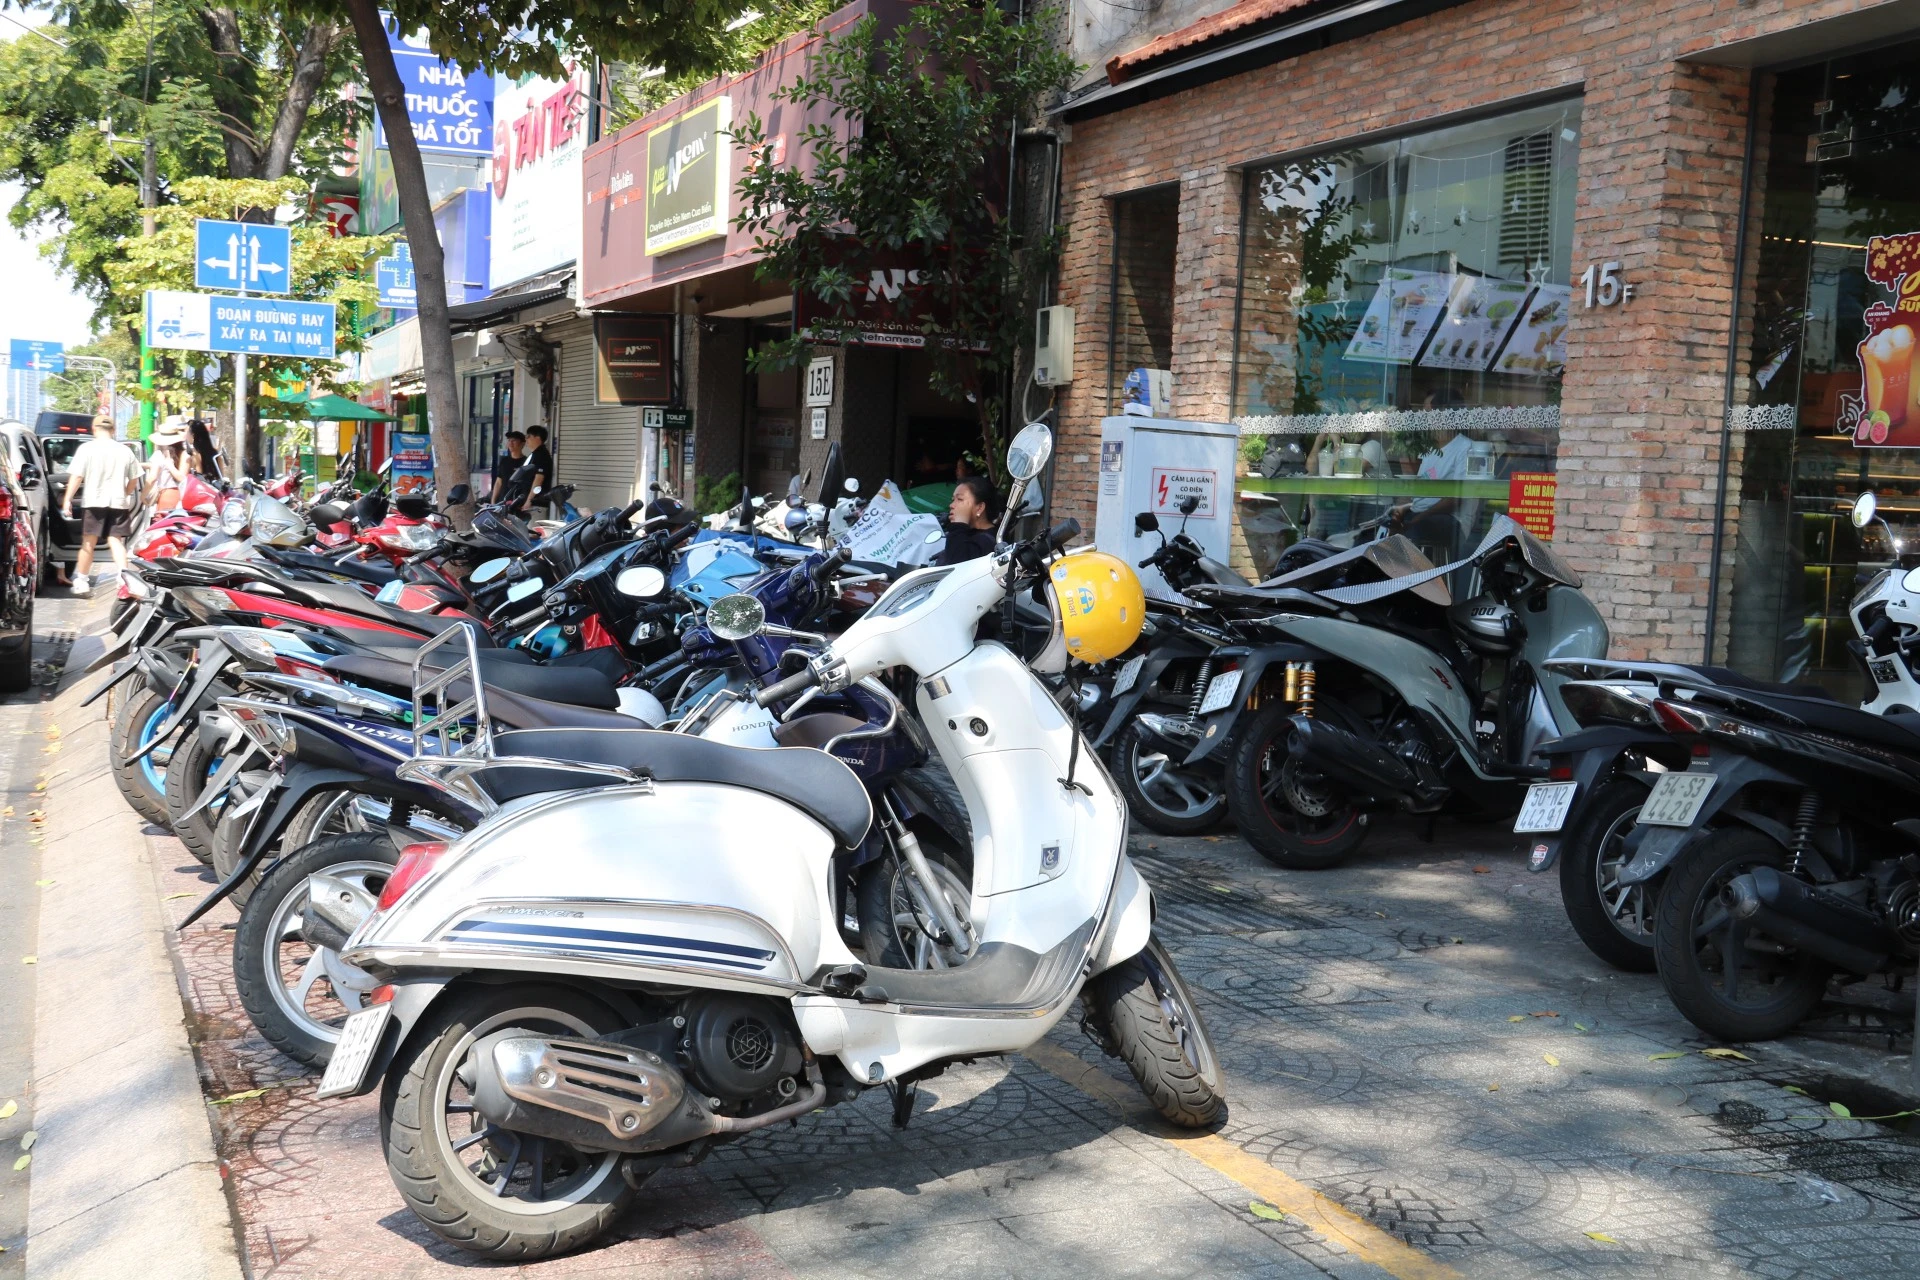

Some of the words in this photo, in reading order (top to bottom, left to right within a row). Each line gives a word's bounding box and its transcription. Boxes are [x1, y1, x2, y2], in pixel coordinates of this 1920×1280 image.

[419, 64, 466, 87] NHÀ
[405, 90, 479, 118] THUỐC
[442, 119, 482, 146] TỐT
[1580, 261, 1633, 308] 15F
[217, 307, 252, 324] ĐOẠN
[256, 308, 297, 326] ĐƯỜNG
[302, 313, 325, 327] HAY
[221, 323, 245, 340] XẢY
[250, 328, 267, 342] RA
[273, 330, 292, 343] TAI
[296, 332, 322, 348] NẠN
[810, 366, 831, 397] 15E
[666, 413, 687, 421] TOILET
[1524, 482, 1540, 497] CẢNH
[1542, 484, 1554, 497] BÁO
[870, 540, 896, 558] WHITE
[895, 514, 925, 540] PALACE
[732, 720, 774, 733] HONDA
[836, 756, 866, 766] ONDA
[1530, 786, 1569, 807] 50-N2
[1660, 776, 1706, 799] 54-S3
[1519, 807, 1563, 830] 442.91
[1647, 799, 1693, 822] 4428
